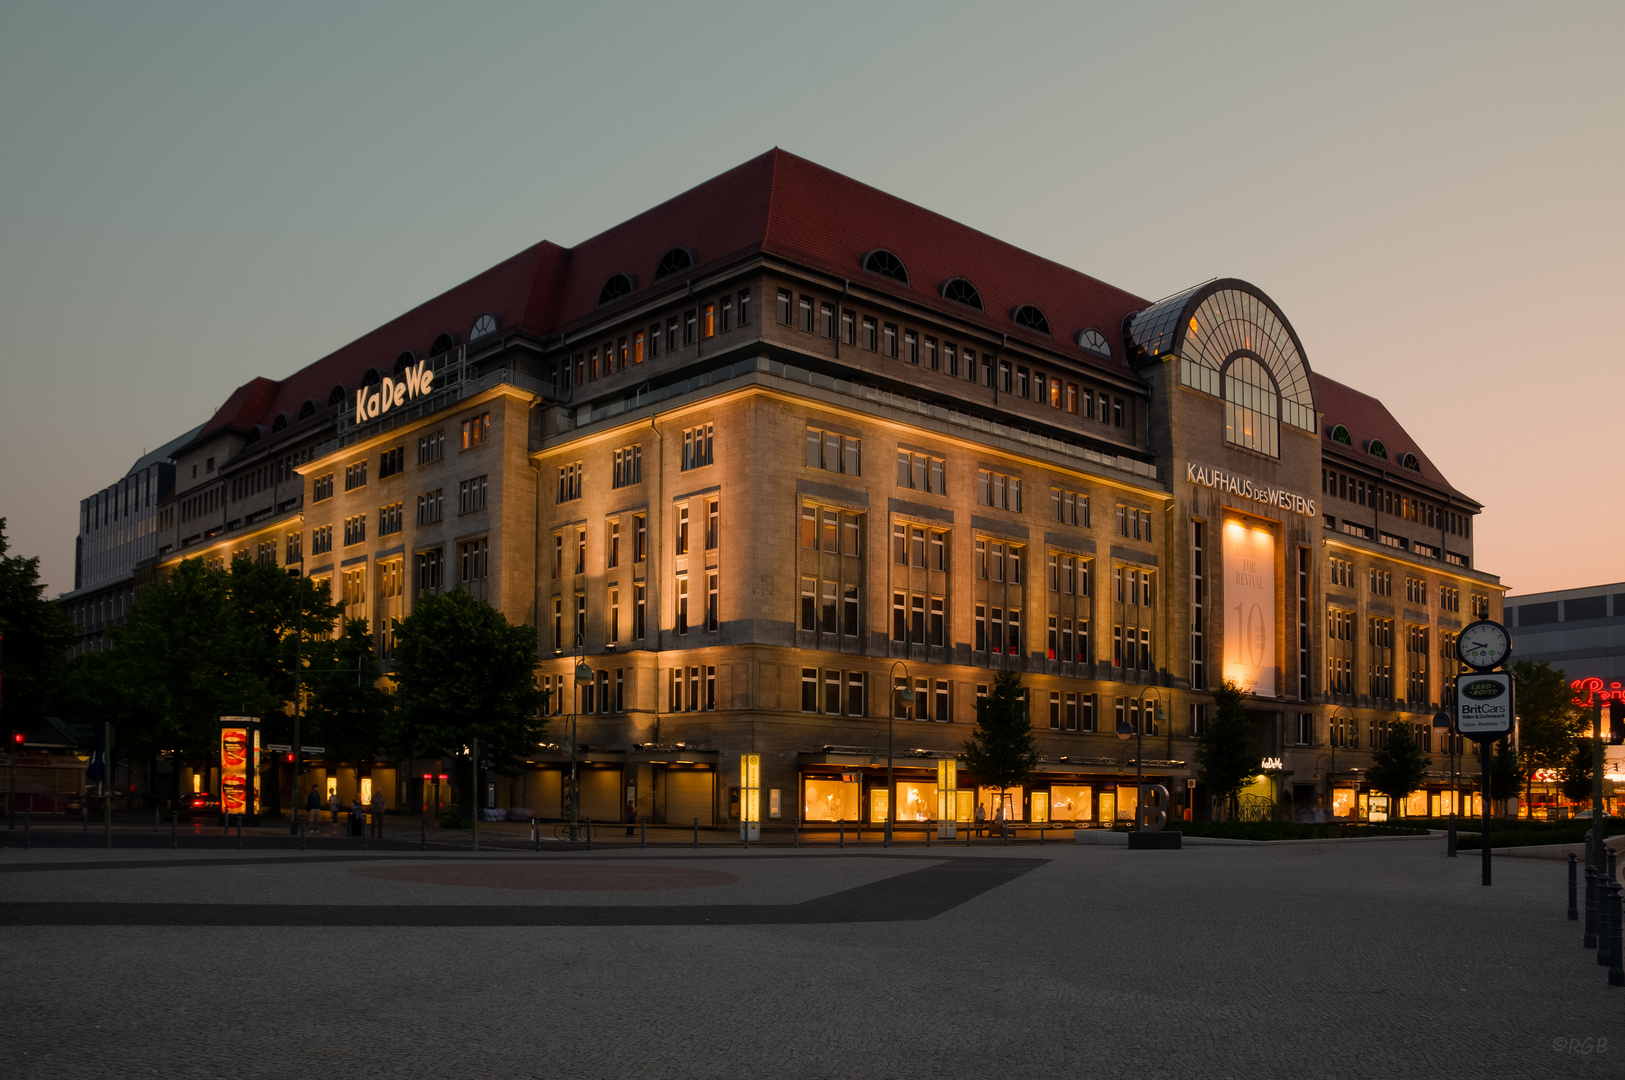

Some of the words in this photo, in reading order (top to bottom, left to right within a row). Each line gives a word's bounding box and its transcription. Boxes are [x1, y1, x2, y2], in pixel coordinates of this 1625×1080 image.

[356, 360, 434, 424] KaDeWe
[1187, 462, 1253, 498] KAUFHAUS
[1254, 488, 1269, 503] DES
[1267, 487, 1315, 517] WESTENS
[1243, 559, 1256, 574] FOR
[1235, 571, 1264, 590] REVIVAL
[1233, 601, 1265, 667] 10
[1462, 704, 1505, 714] BritCars
[15, 757, 52, 766] IMBISS
